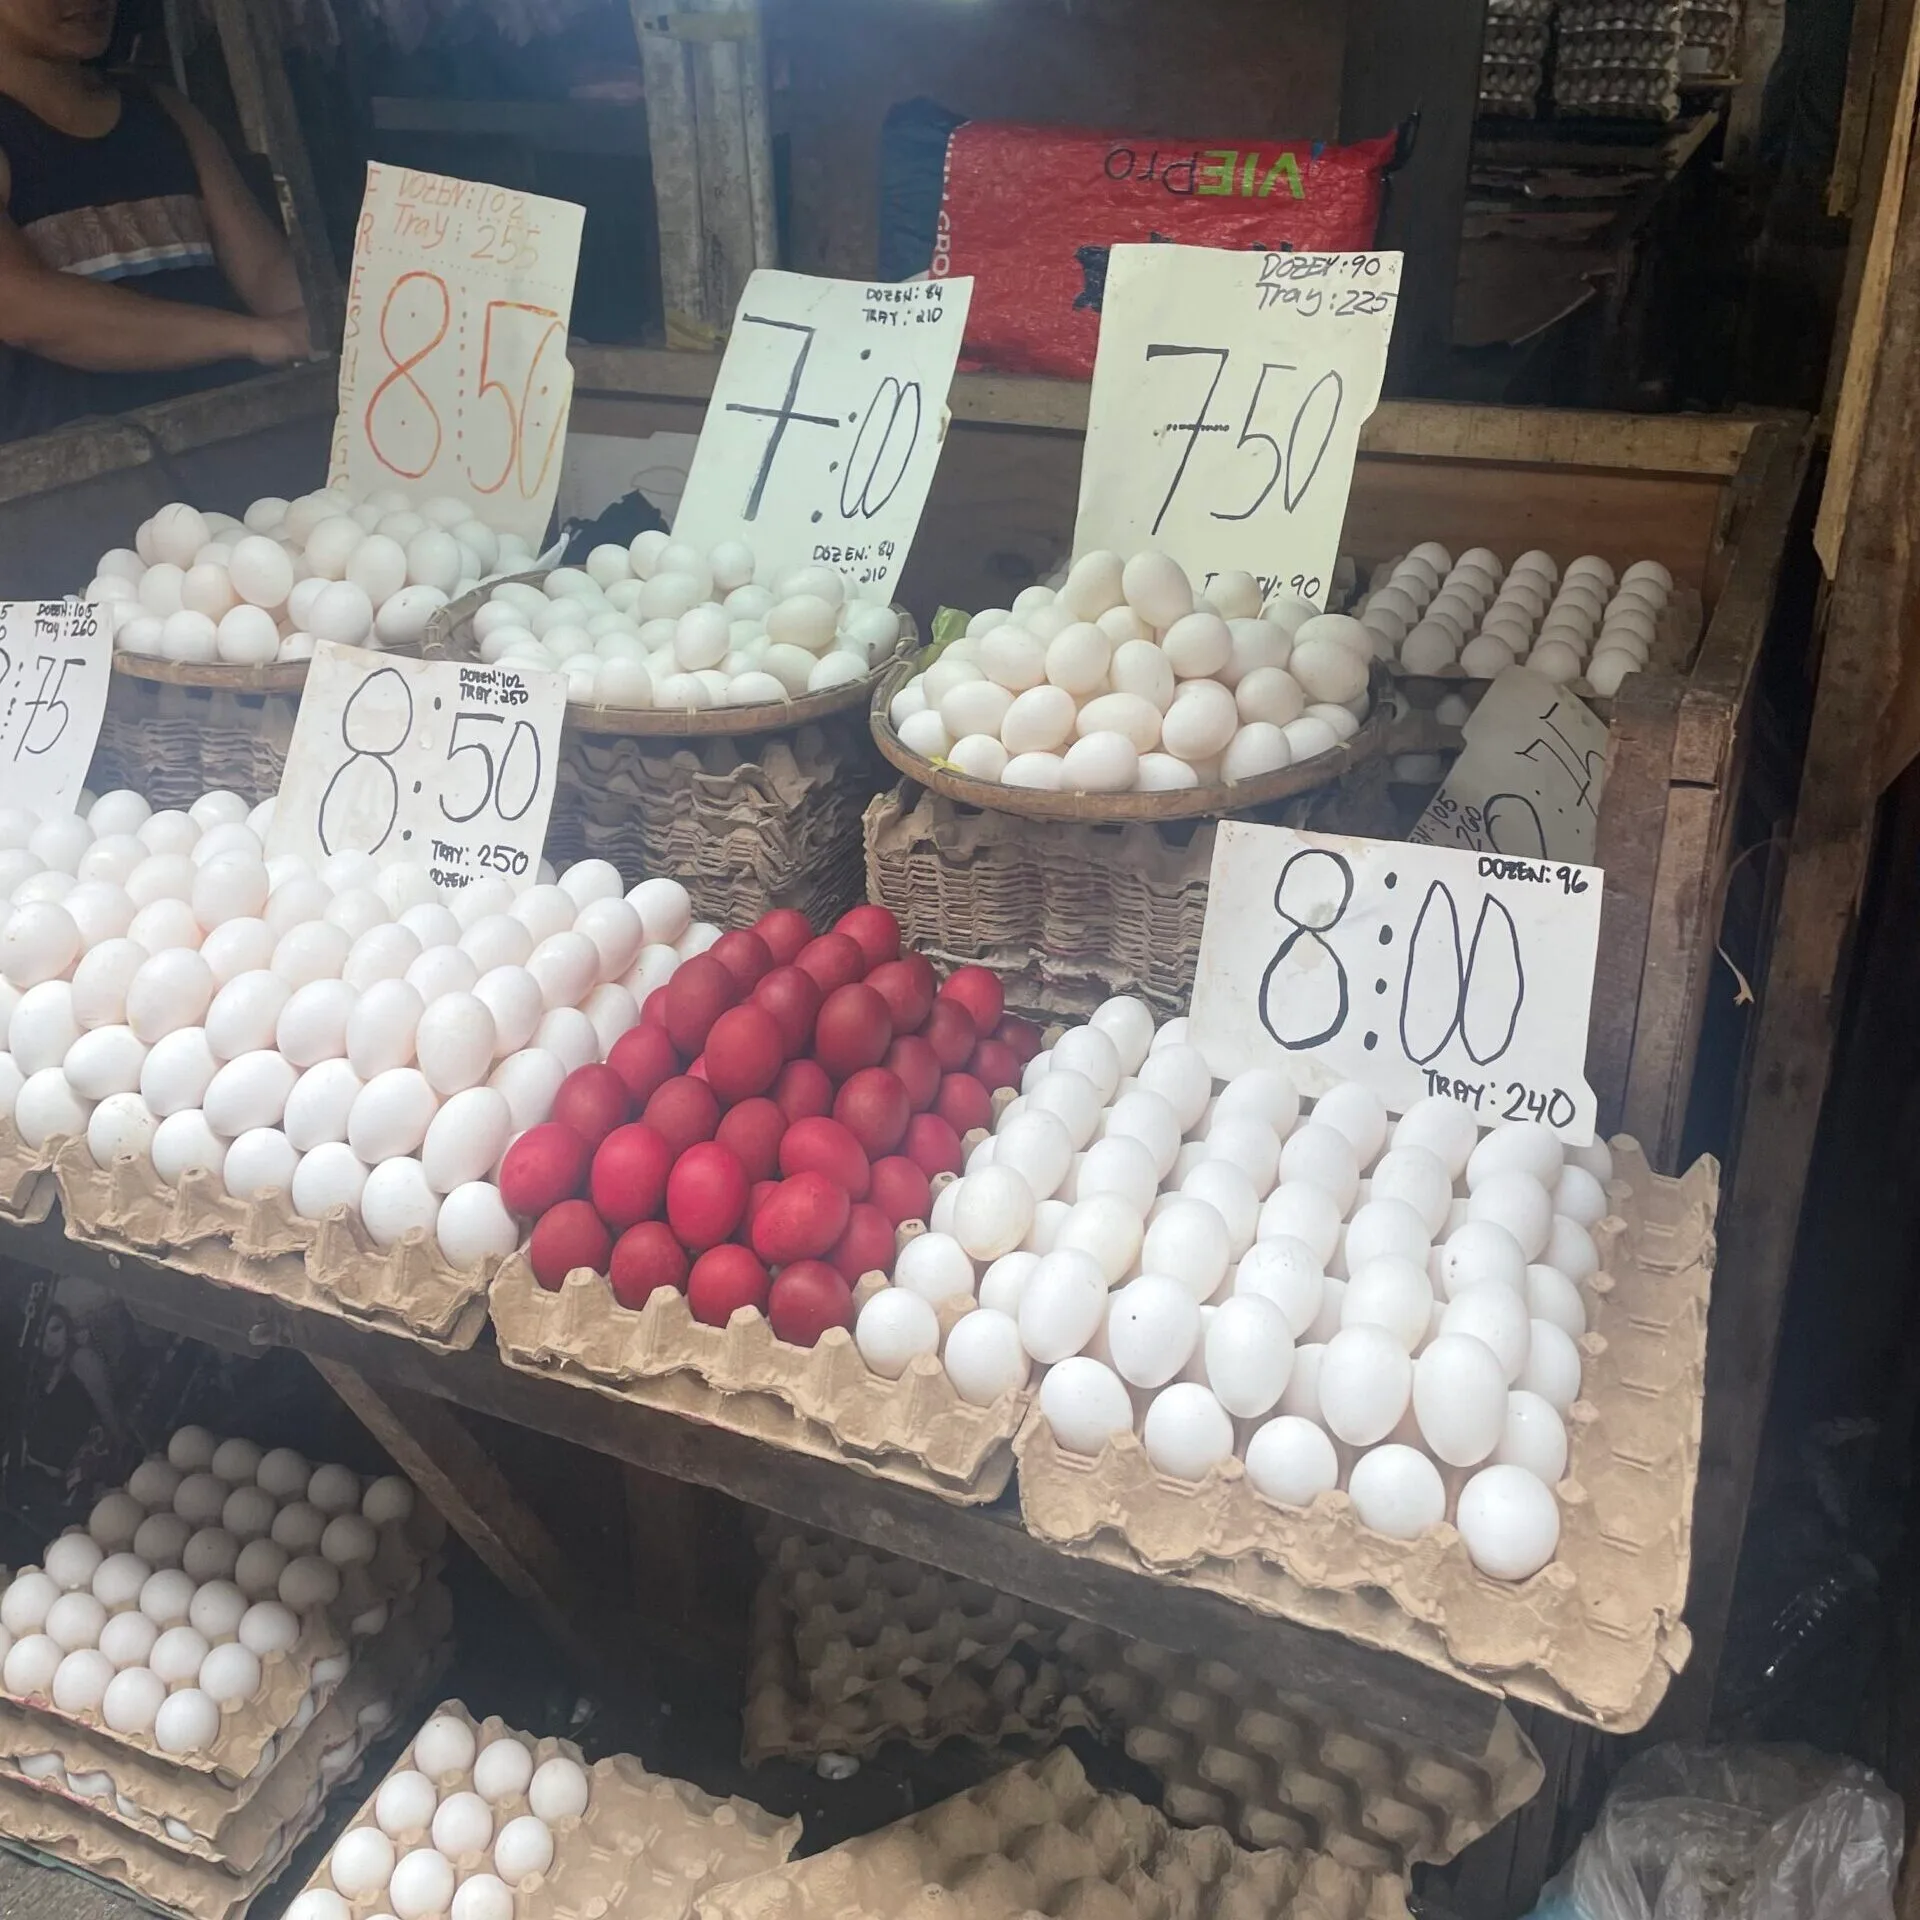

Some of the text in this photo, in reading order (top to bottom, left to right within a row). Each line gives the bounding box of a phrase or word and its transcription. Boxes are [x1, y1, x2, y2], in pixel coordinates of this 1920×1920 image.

[925, 283, 943, 301] 84
[916, 307, 943, 323] 210
[1146, 344, 1343, 535] 750
[878, 540, 895, 561] 84
[860, 566, 887, 583] 210
[0, 648, 86, 762] :75
[477, 844, 529, 875] 250
[1556, 866, 1588, 895] 96
[1258, 848, 1524, 1066] 8:00
[1501, 1082, 1576, 1128] 240
